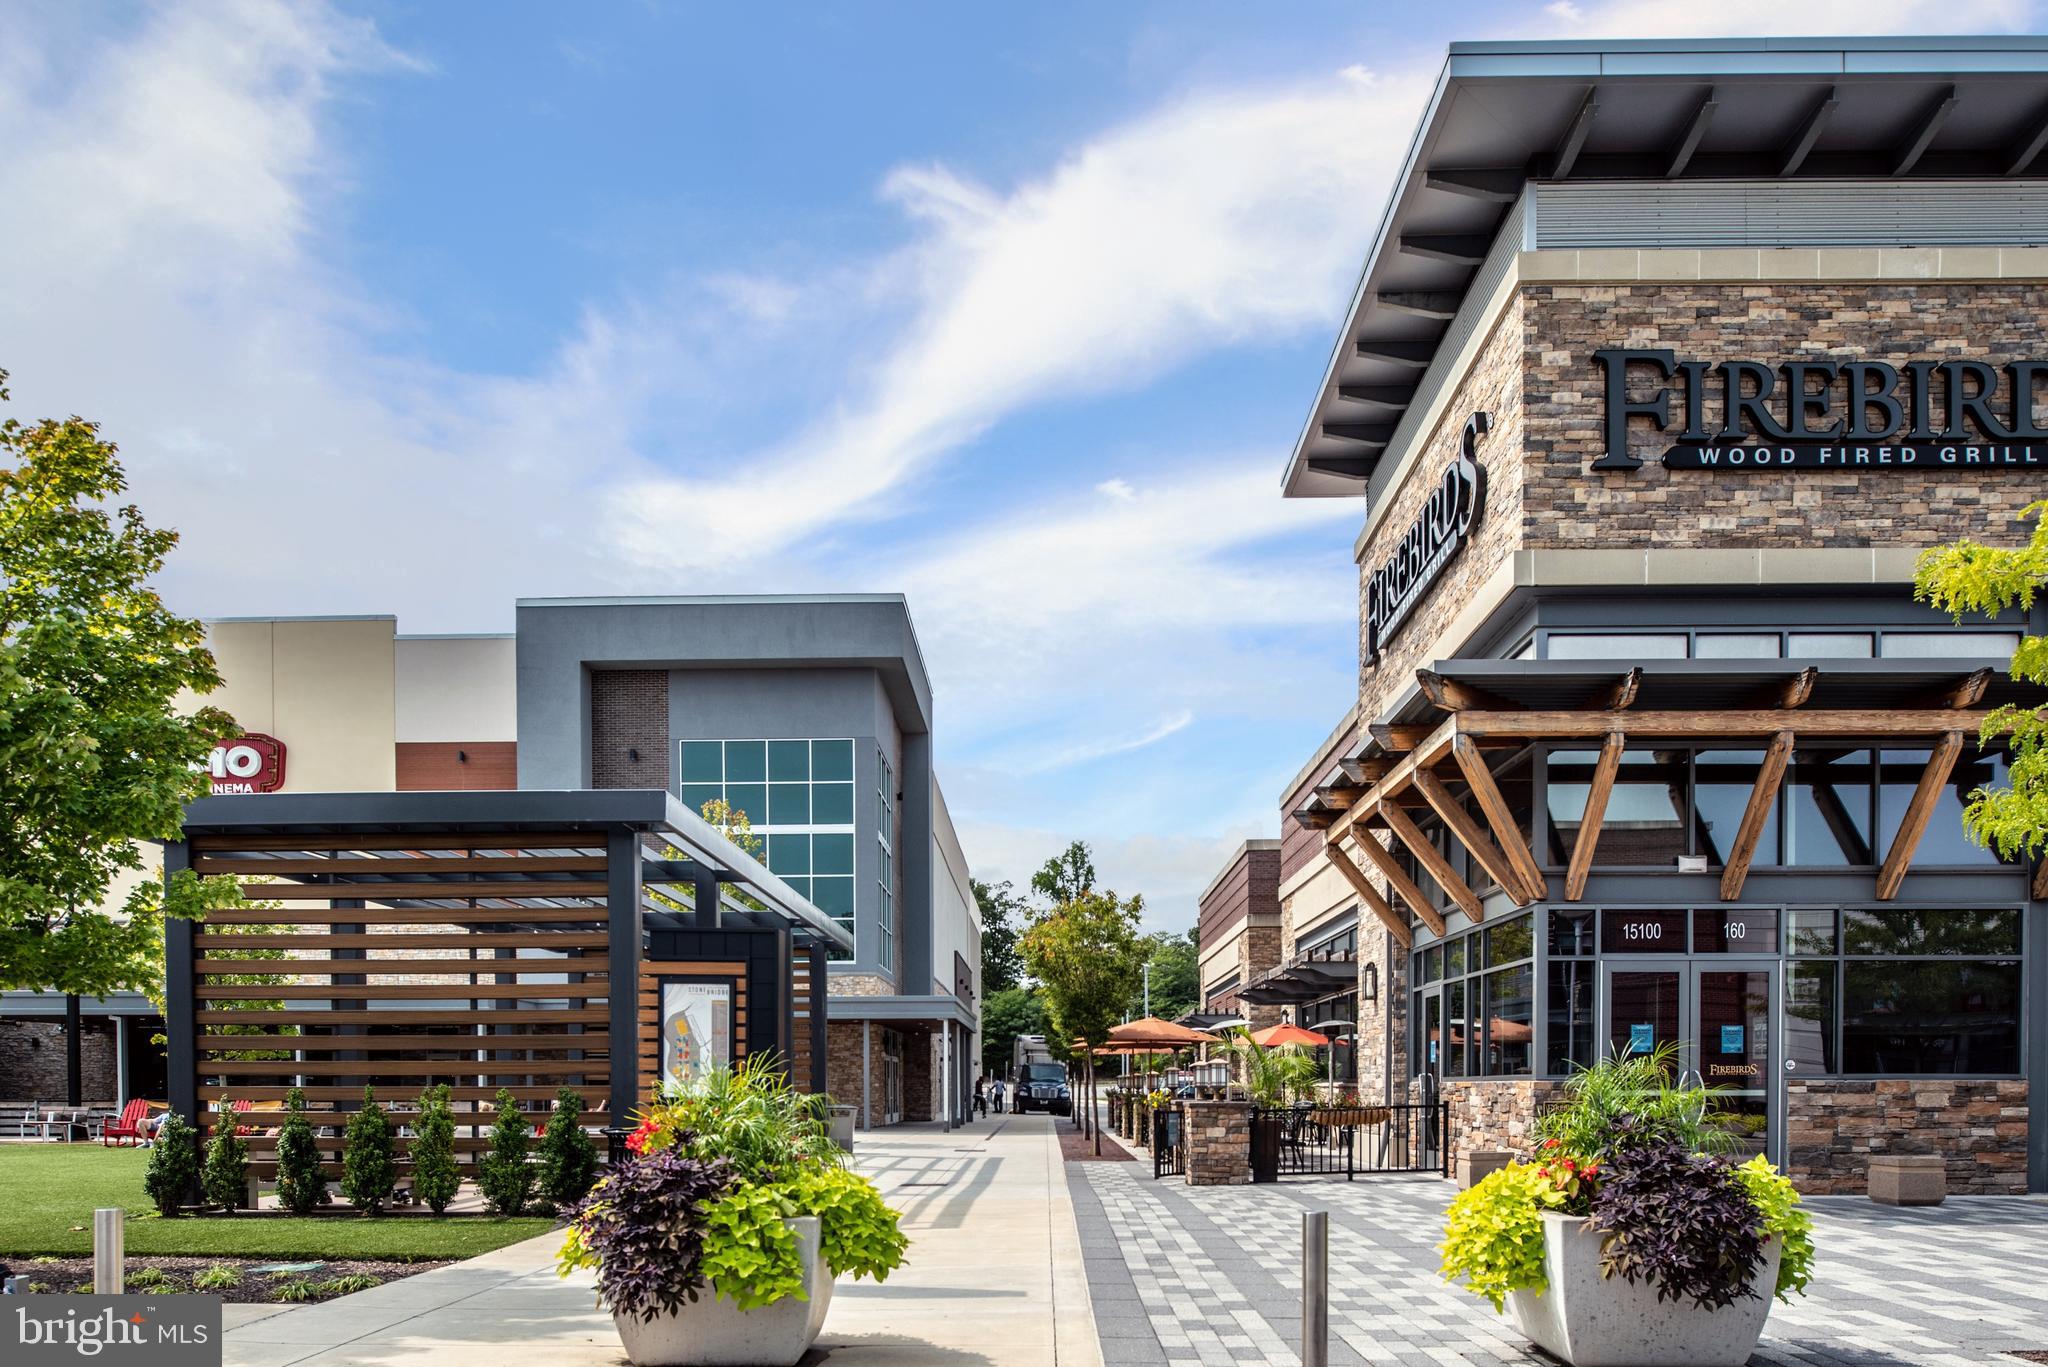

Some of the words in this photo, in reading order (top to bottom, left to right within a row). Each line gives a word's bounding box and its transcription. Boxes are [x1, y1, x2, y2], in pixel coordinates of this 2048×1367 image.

[1698, 448, 1796, 464] WOOD
[1819, 448, 1917, 464] FIRED
[1940, 447, 2038, 463] GRILL
[1363, 411, 1488, 667] FIREBIRDS
[1427, 542, 1451, 580] GRILL
[1623, 923, 1662, 940] 15100
[1724, 922, 1746, 939] 160
[1710, 1064, 1758, 1075] FIREBIRDS
